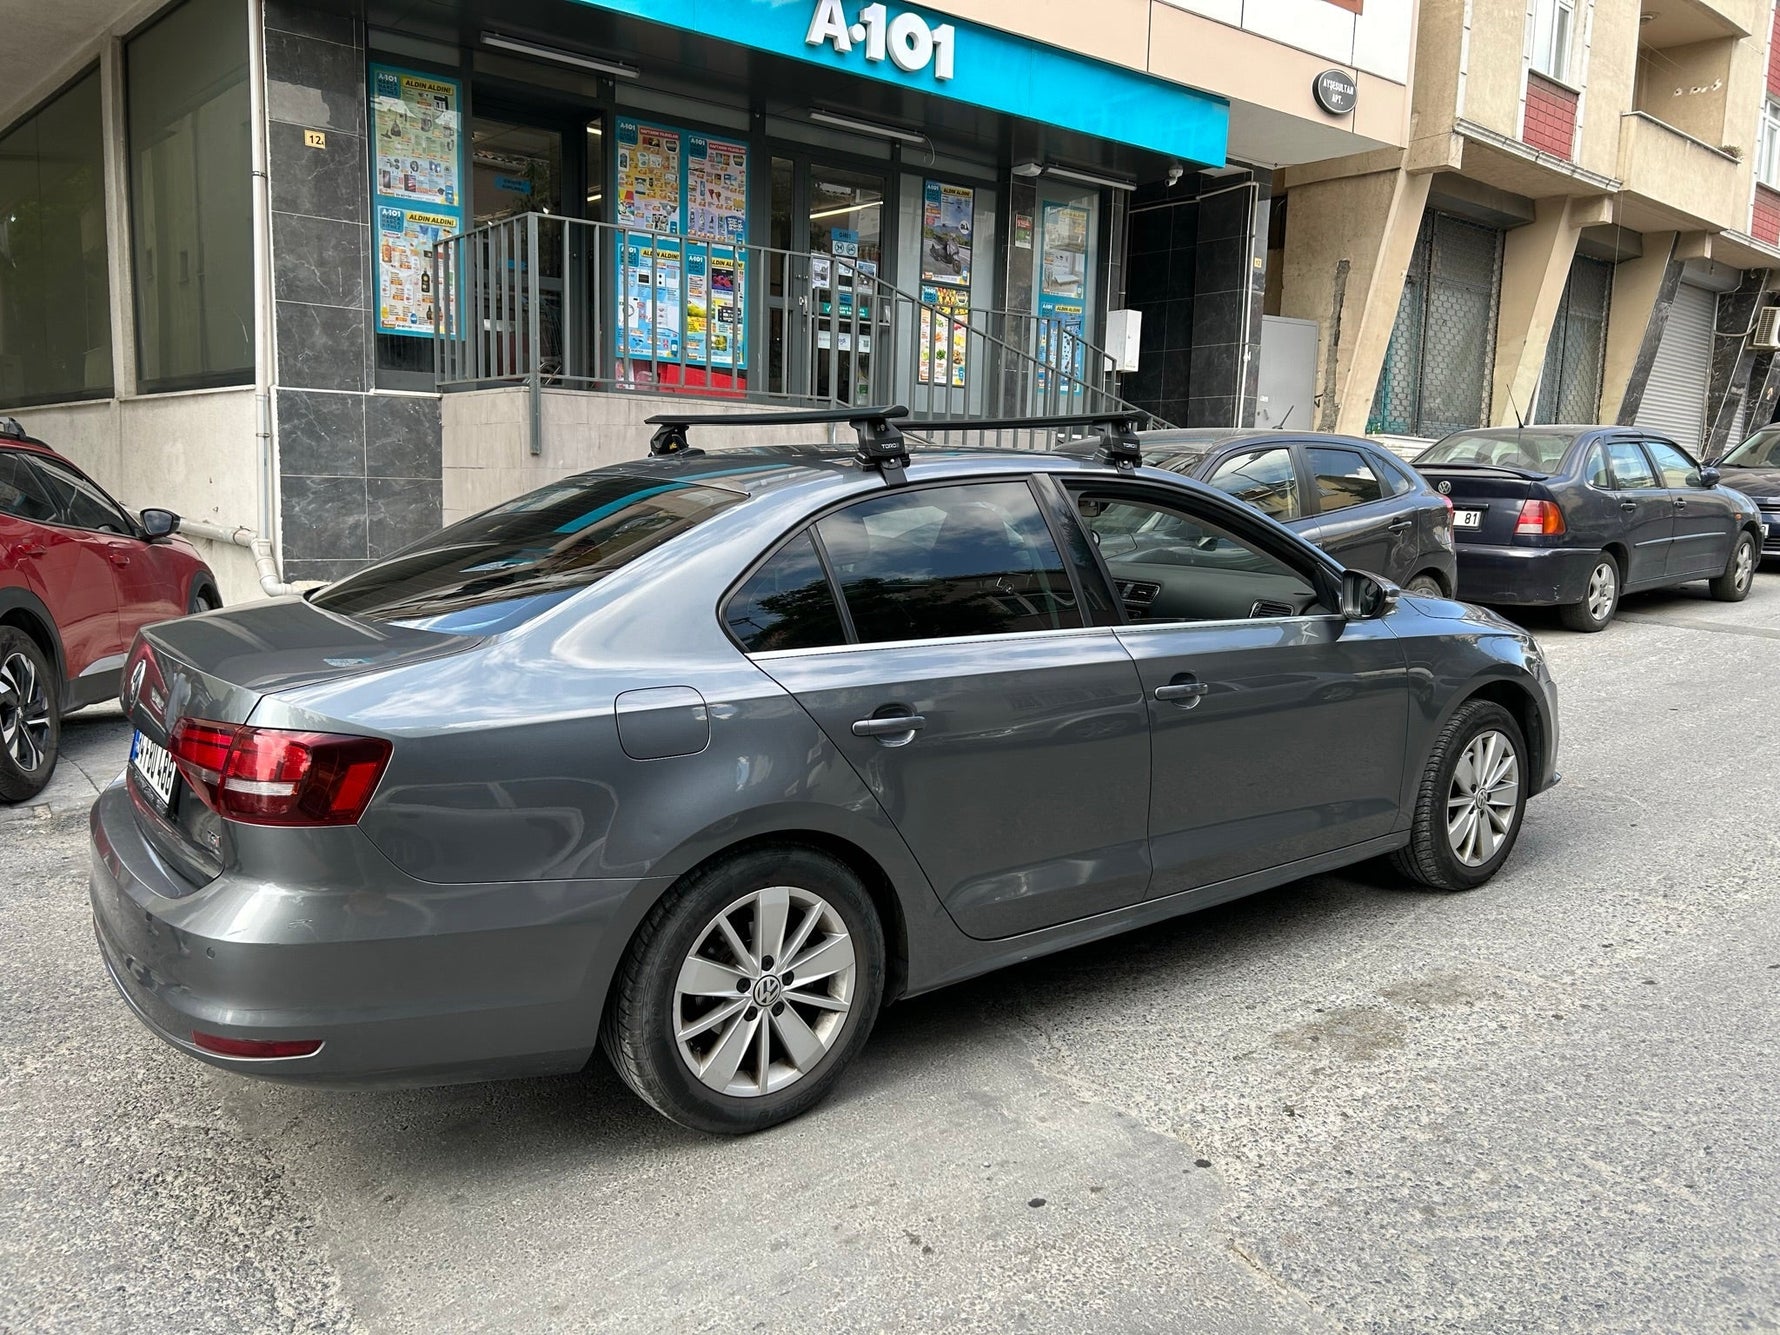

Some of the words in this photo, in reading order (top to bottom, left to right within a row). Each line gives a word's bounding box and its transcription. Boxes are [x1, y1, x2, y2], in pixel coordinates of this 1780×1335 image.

[405, 80, 427, 90] ALDIN
[428, 83, 451, 94] ALDIN!
[1332, 93, 1344, 105] APT.
[408, 214, 430, 222] ALDIN
[430, 217, 454, 226] ALDIN!
[1464, 512, 1478, 525] 81
